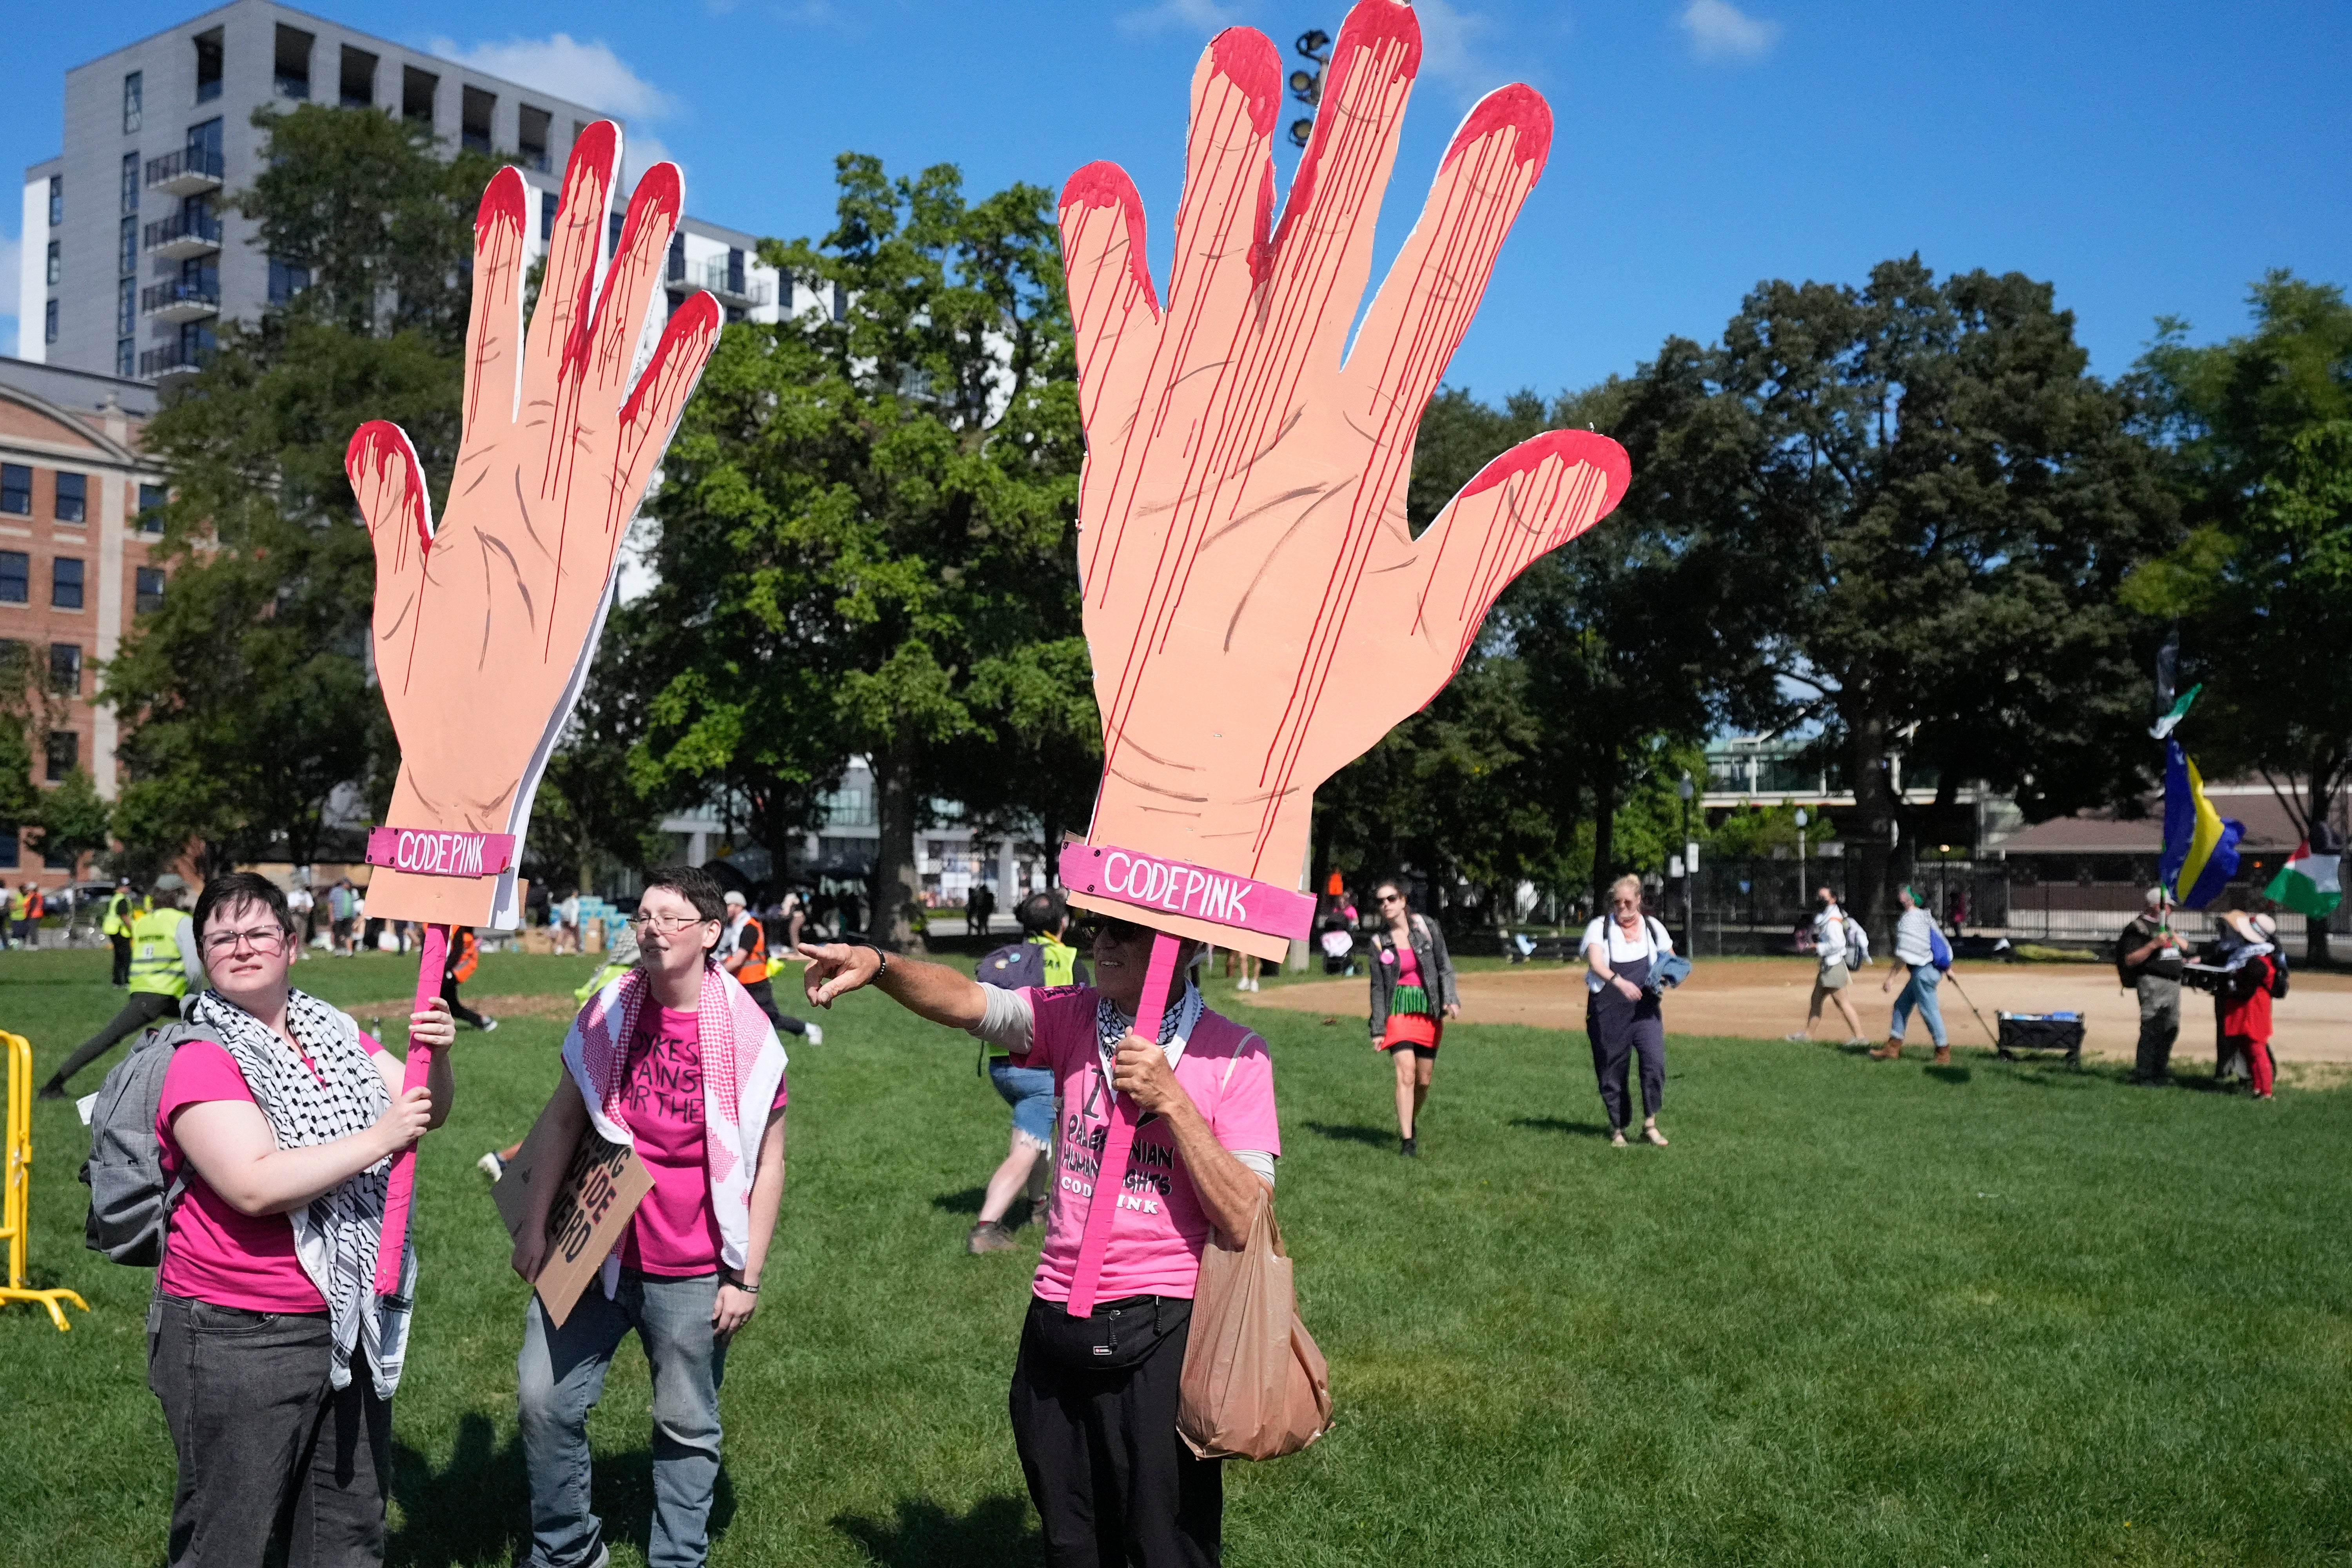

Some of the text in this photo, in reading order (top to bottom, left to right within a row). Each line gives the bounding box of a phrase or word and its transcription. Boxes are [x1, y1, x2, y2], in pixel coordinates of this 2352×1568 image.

[397, 831, 486, 874] CODEPINK
[1104, 852, 1252, 922] CODEPINK
[630, 1060, 698, 1093] AINS
[1068, 1114, 1175, 1170] PALENIAN
[568, 1148, 618, 1225] OCIDE
[1061, 1176, 1159, 1214] CODINK
[1123, 1168, 1172, 1195] GHTS
